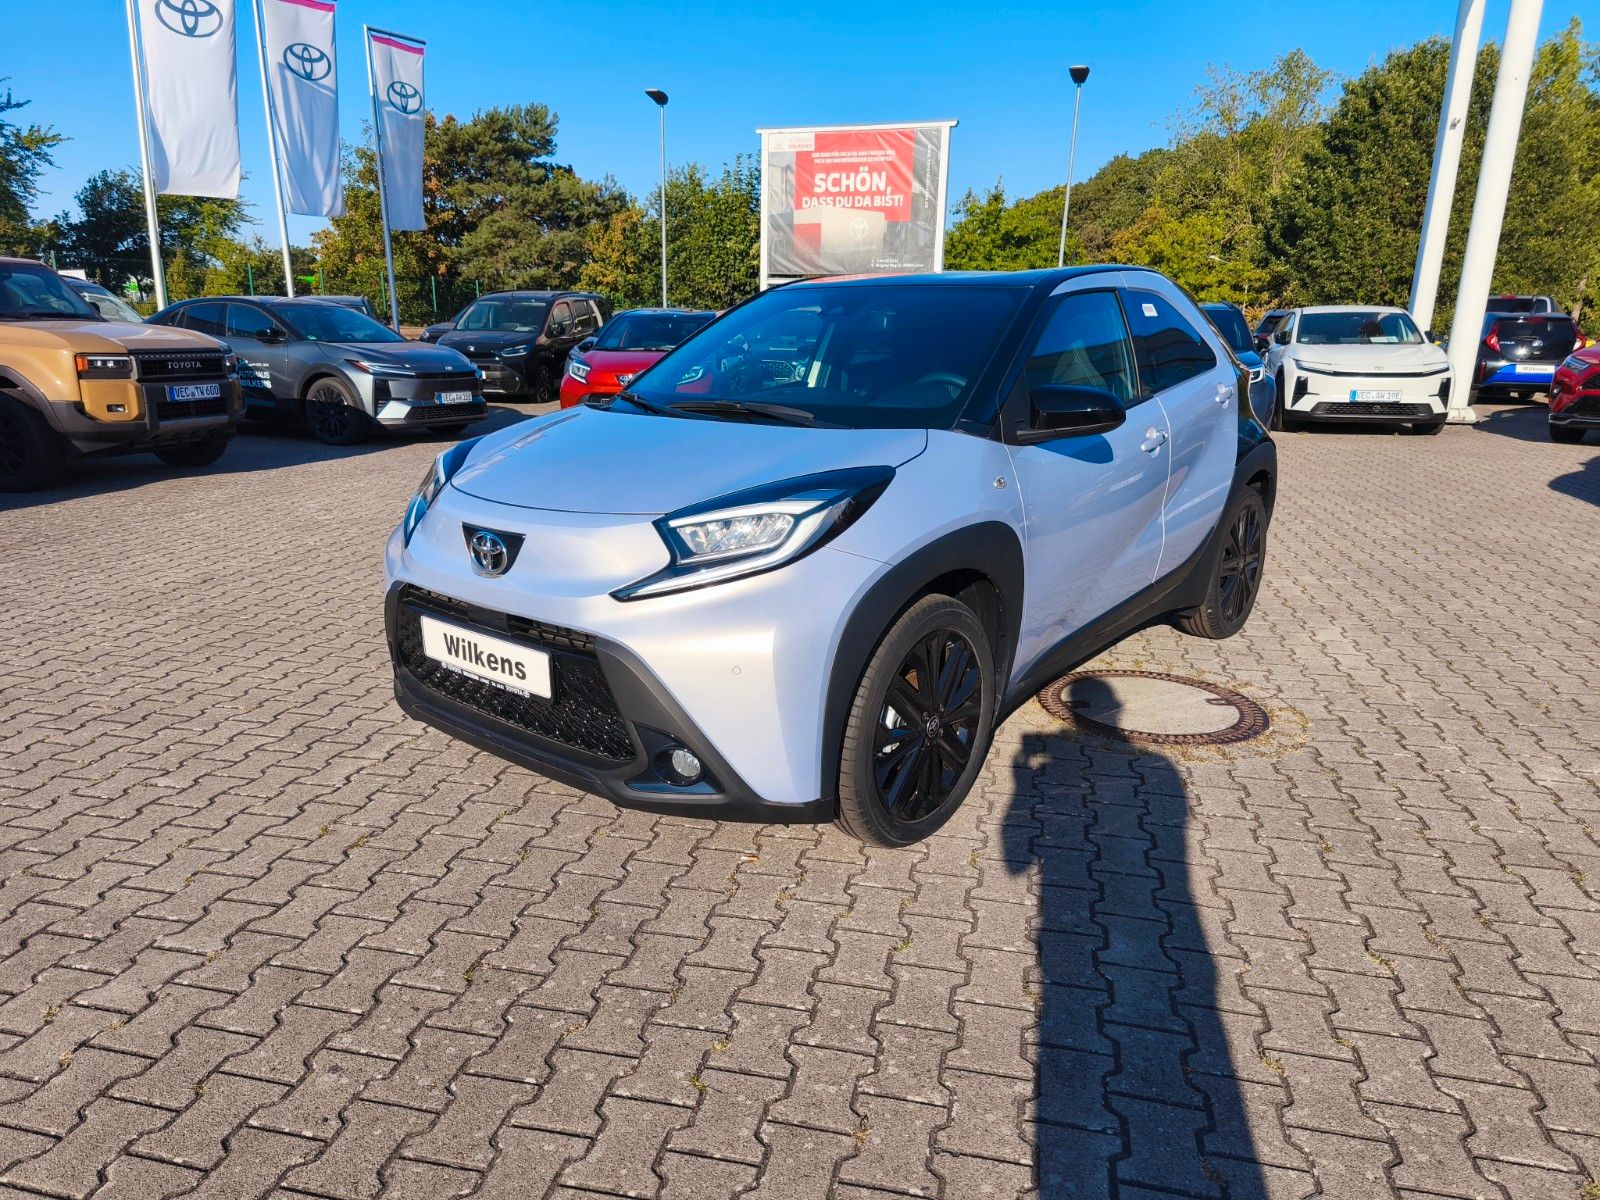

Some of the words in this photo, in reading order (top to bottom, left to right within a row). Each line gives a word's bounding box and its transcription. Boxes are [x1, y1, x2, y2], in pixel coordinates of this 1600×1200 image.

[813, 166, 892, 195] SCHÖN,
[802, 196, 833, 209] DASS
[835, 195, 853, 208] DU
[854, 195, 871, 207] DA
[873, 194, 904, 207] BIST!
[167, 361, 202, 369] TOYOTA
[174, 385, 191, 398] VEC
[195, 385, 205, 398] TW
[205, 384, 219, 396] 600
[443, 632, 527, 681] Wilkens
